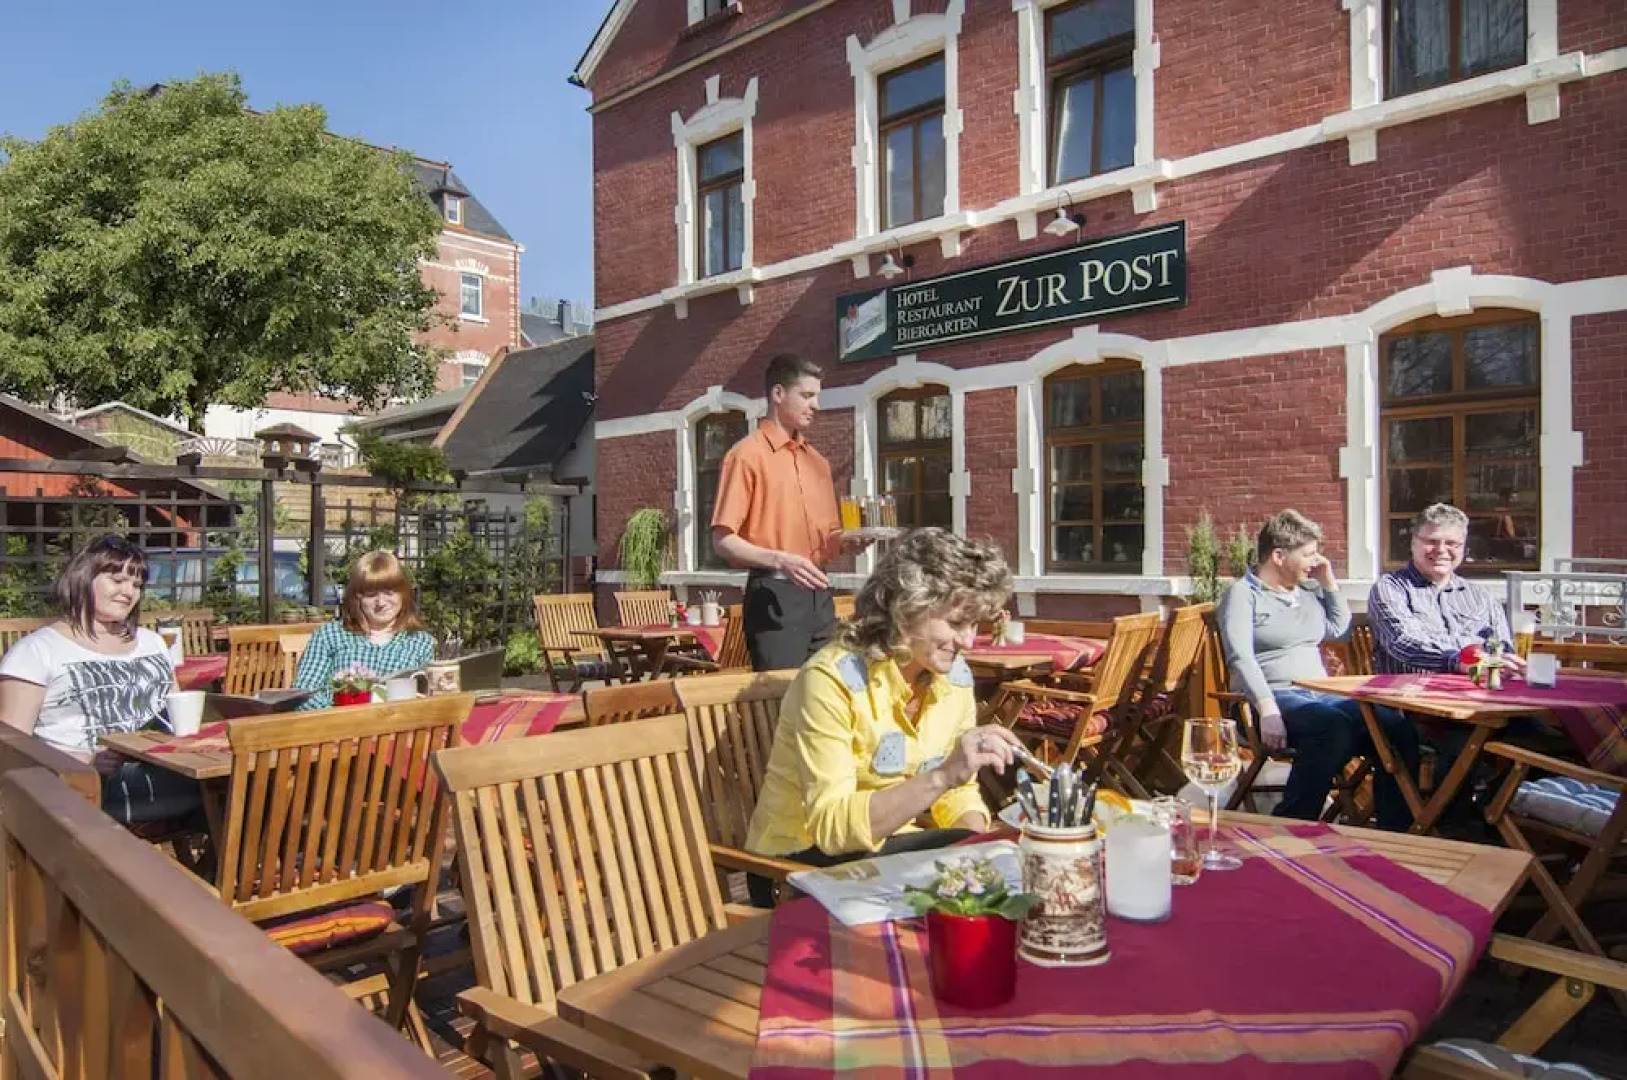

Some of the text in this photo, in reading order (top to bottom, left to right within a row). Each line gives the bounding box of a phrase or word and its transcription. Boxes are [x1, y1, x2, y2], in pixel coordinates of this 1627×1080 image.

[995, 250, 1178, 317] ZUR POST
[897, 289, 939, 308] HOTEL
[897, 297, 982, 325] RESTAURANT
[897, 316, 978, 342] BIERGARTEN
